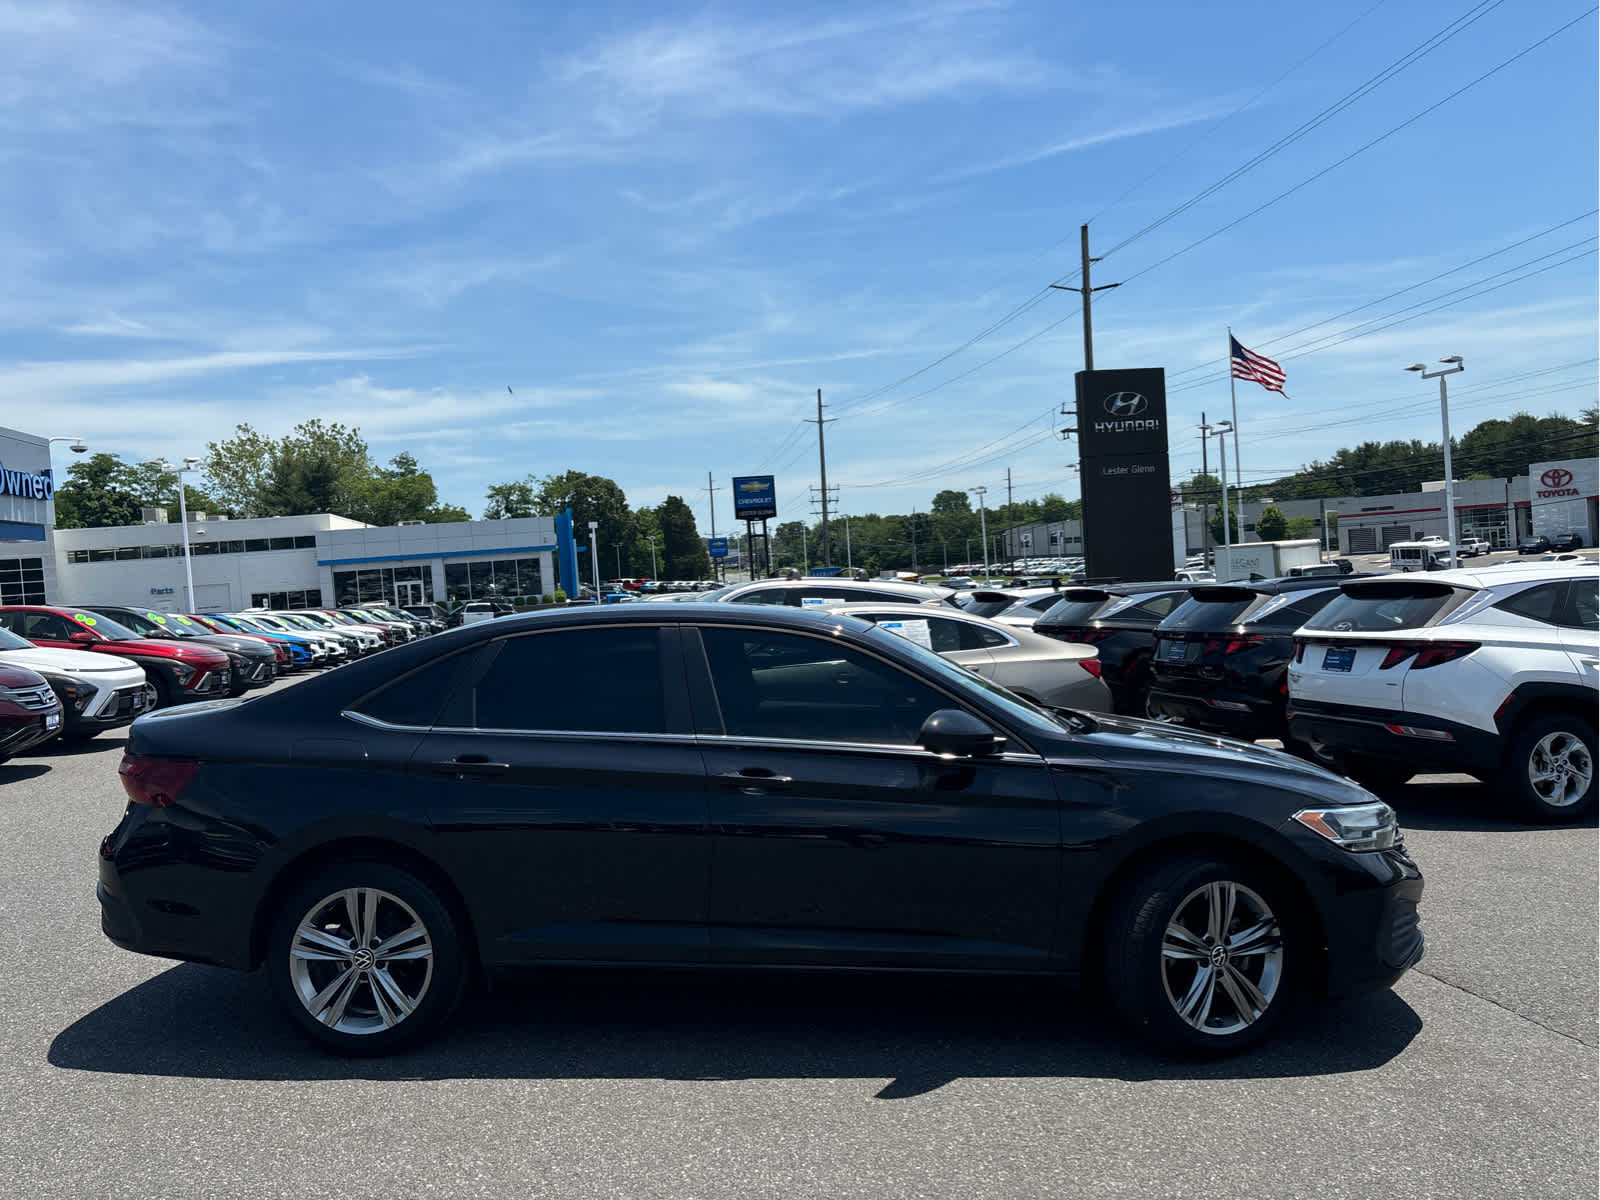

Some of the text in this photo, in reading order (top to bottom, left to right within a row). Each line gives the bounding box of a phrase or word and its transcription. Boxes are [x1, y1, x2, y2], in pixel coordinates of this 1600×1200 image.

[1095, 419, 1160, 433] HYUNDAI
[1103, 464, 1156, 476] Lester Glenn
[1536, 488, 1580, 499] TOYOTA
[738, 497, 772, 505] CHEVROLET
[1231, 557, 1260, 569] LEGANT
[151, 587, 174, 596] Parts
